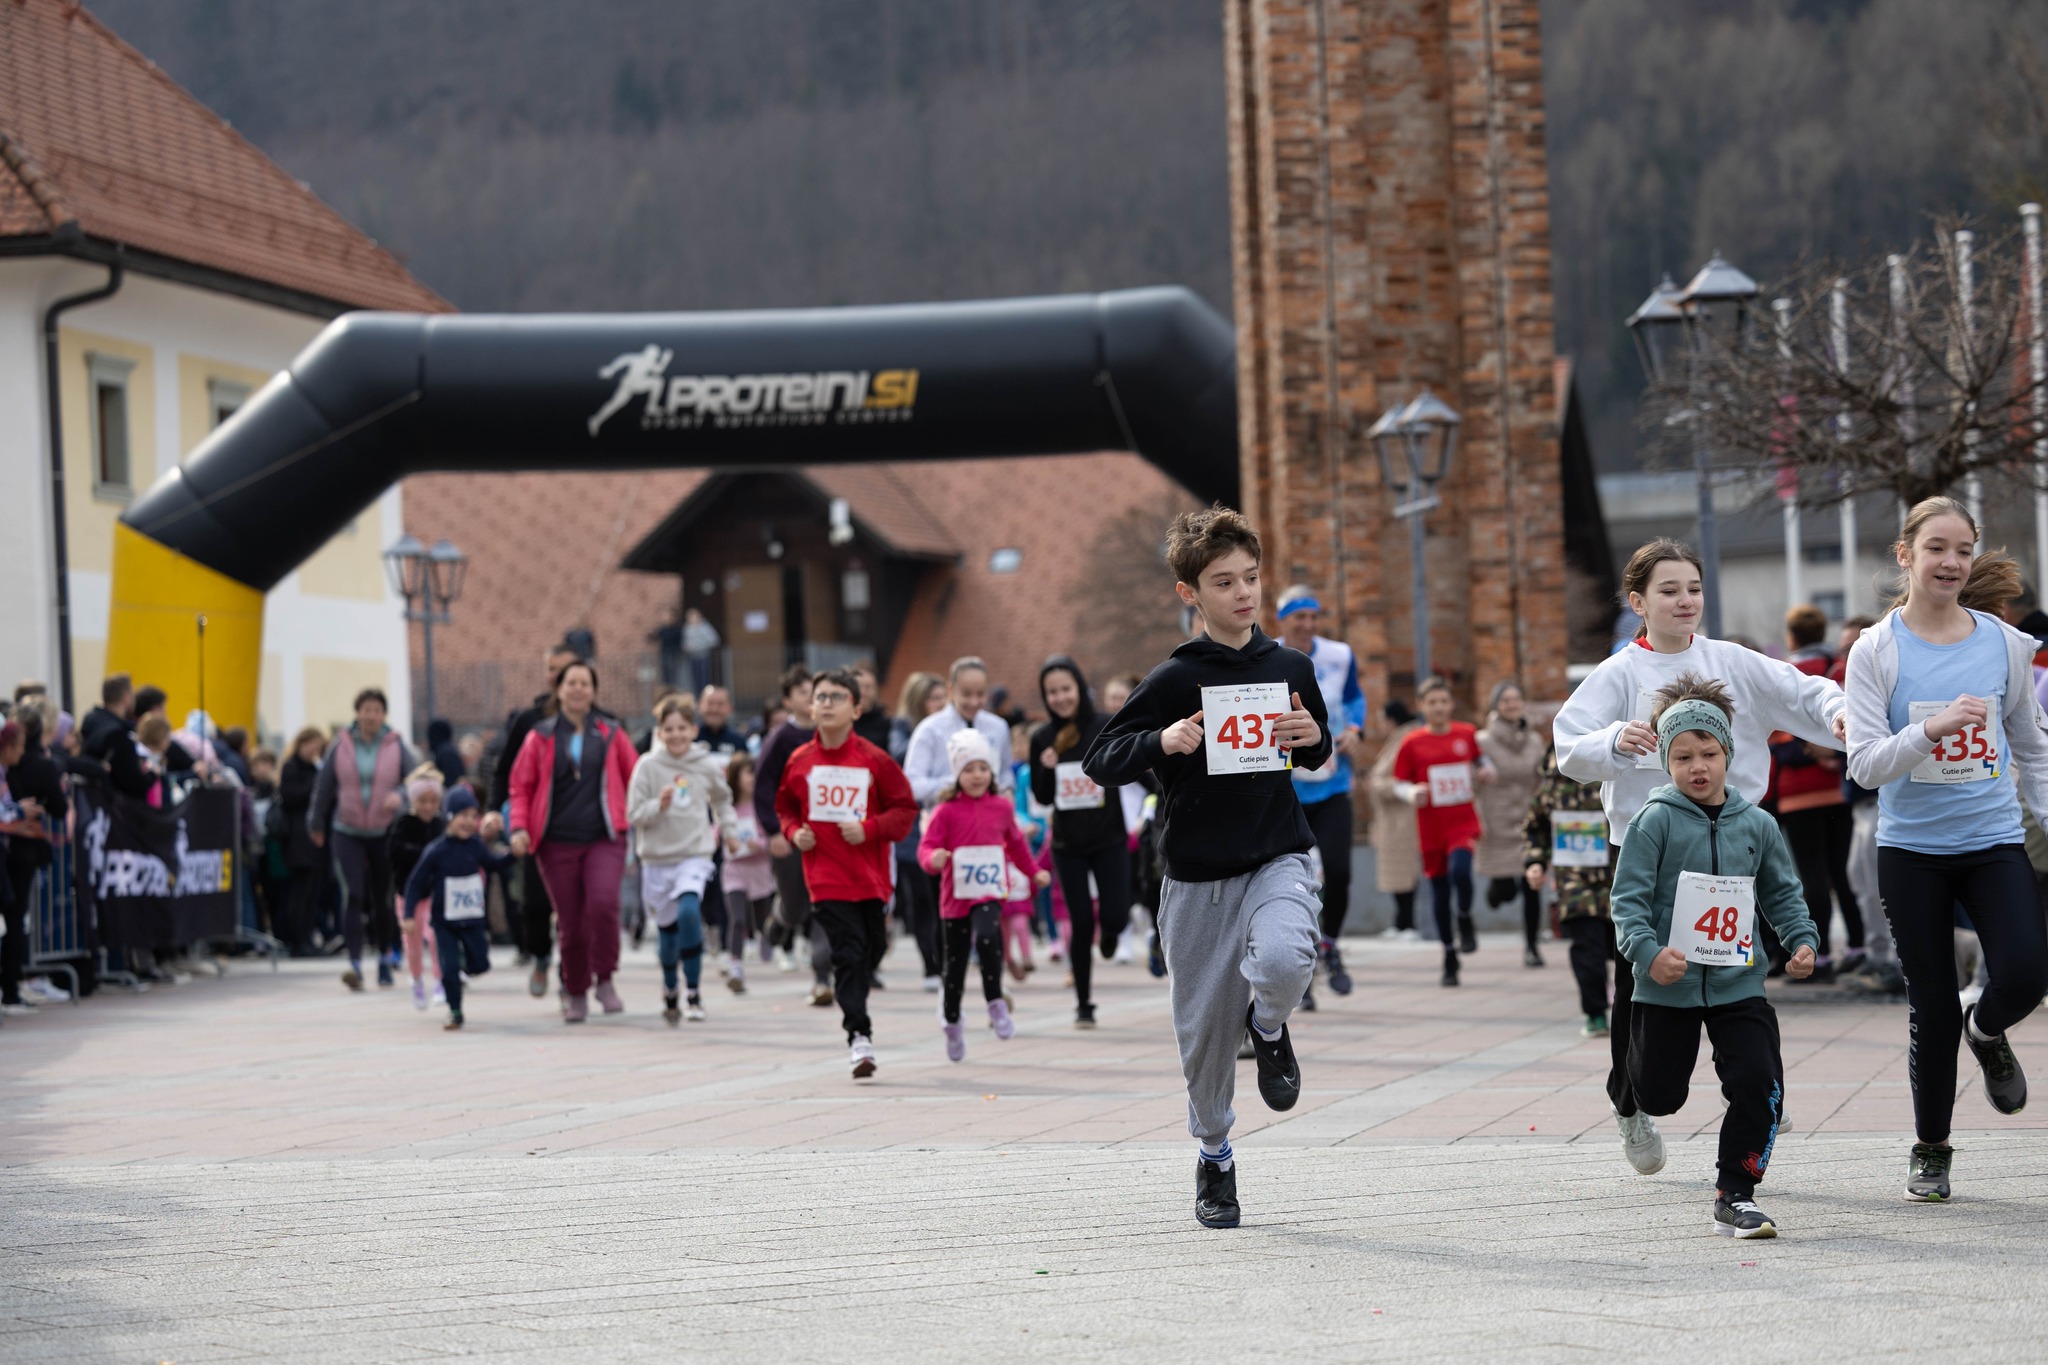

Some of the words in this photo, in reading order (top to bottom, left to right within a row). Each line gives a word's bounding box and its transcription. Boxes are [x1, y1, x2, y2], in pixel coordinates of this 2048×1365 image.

[640, 413, 705, 431] SPORT
[713, 411, 828, 429] NUTRITION
[835, 408, 915, 426] CENTER
[1217, 712, 1284, 750] 437
[1239, 755, 1256, 764] Cutie
[1256, 754, 1270, 763] pies
[1960, 766, 1974, 775] pies
[816, 784, 860, 807] 307
[961, 863, 1000, 885] 762
[1694, 906, 1739, 943] 48
[1695, 946, 1713, 956] Aljaž
[1713, 948, 1733, 956] Blatnik
